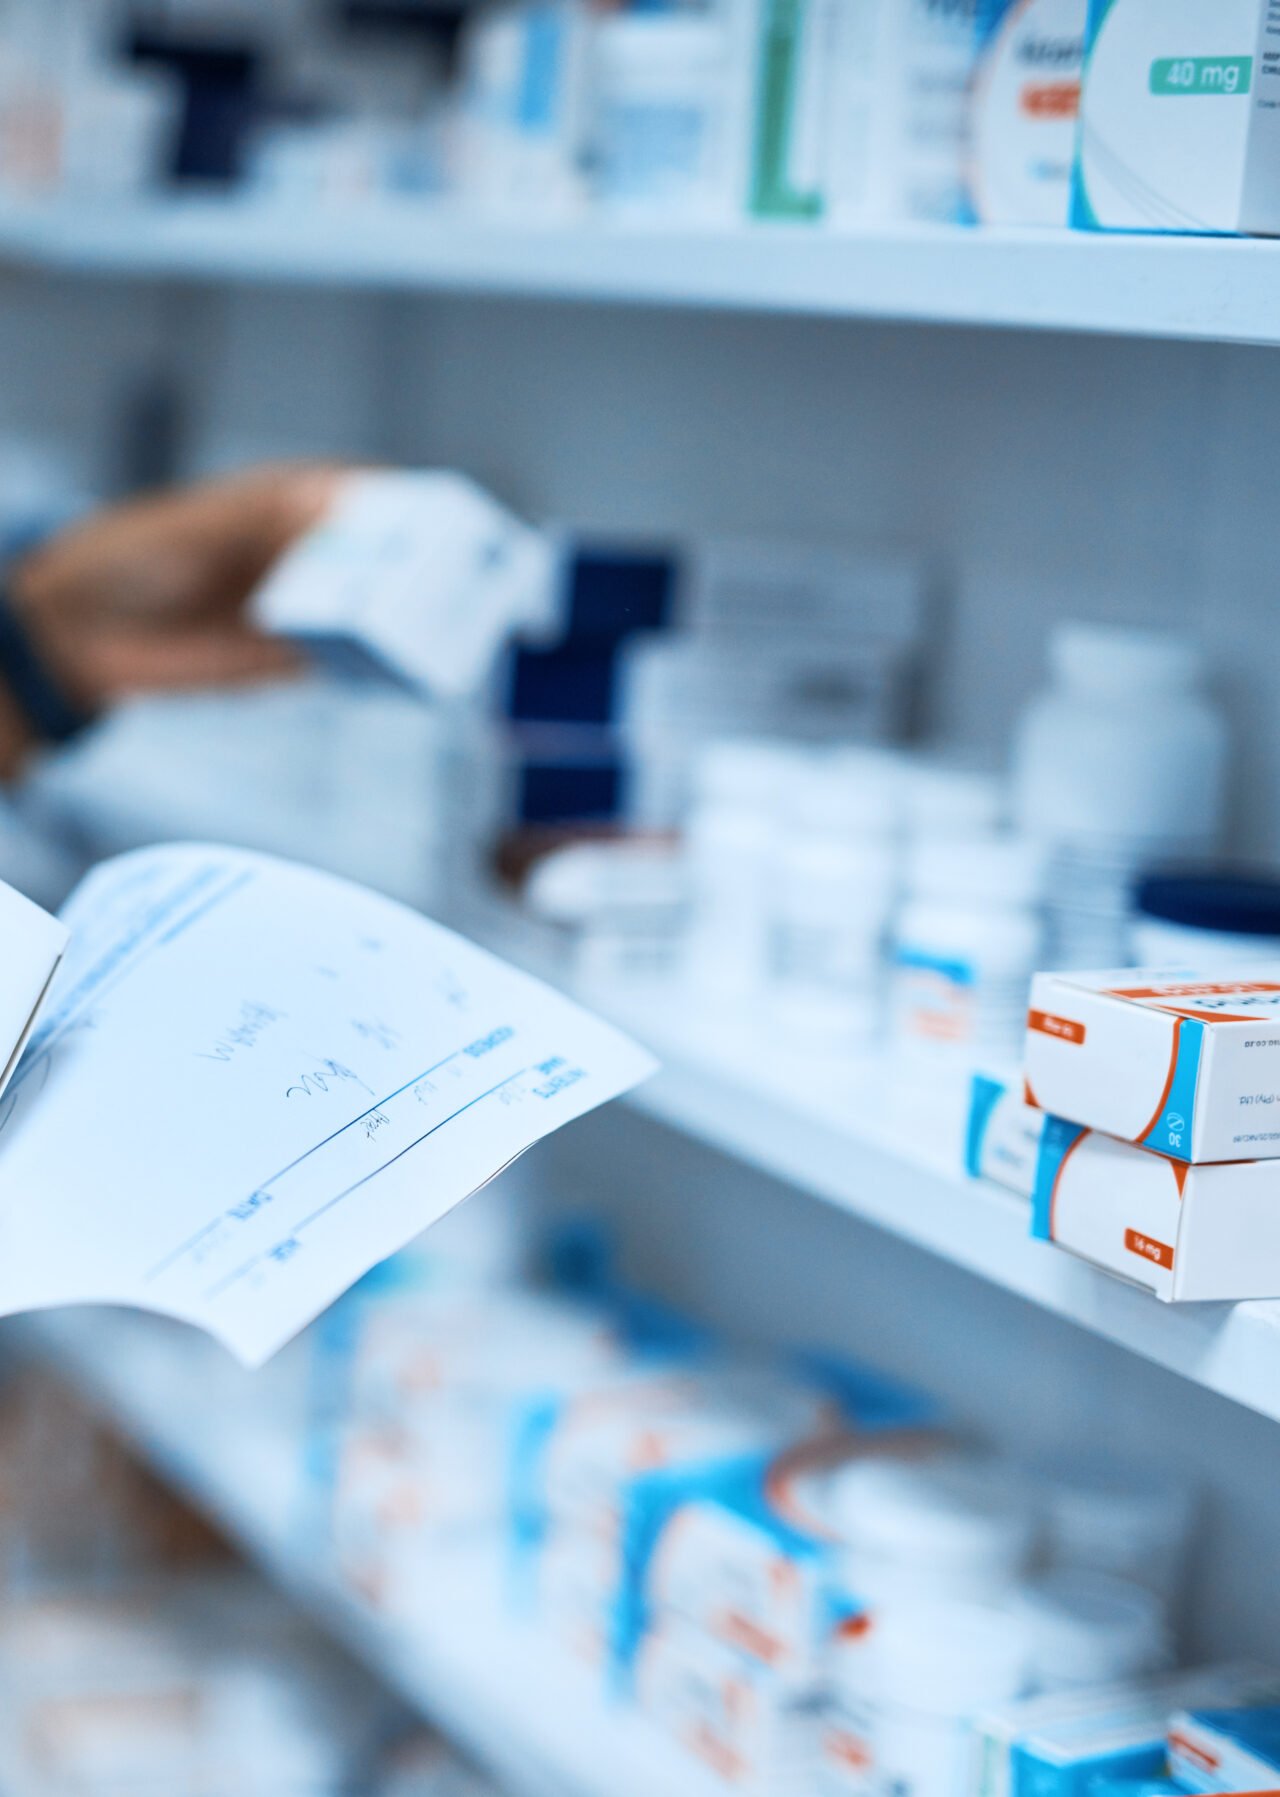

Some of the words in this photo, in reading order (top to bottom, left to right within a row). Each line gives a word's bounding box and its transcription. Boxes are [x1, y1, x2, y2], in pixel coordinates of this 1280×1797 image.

[1166, 61, 1194, 86] 40
[1200, 66, 1239, 92] mg
[1168, 1132, 1182, 1148] 30
[1146, 1244, 1161, 1260] mg
